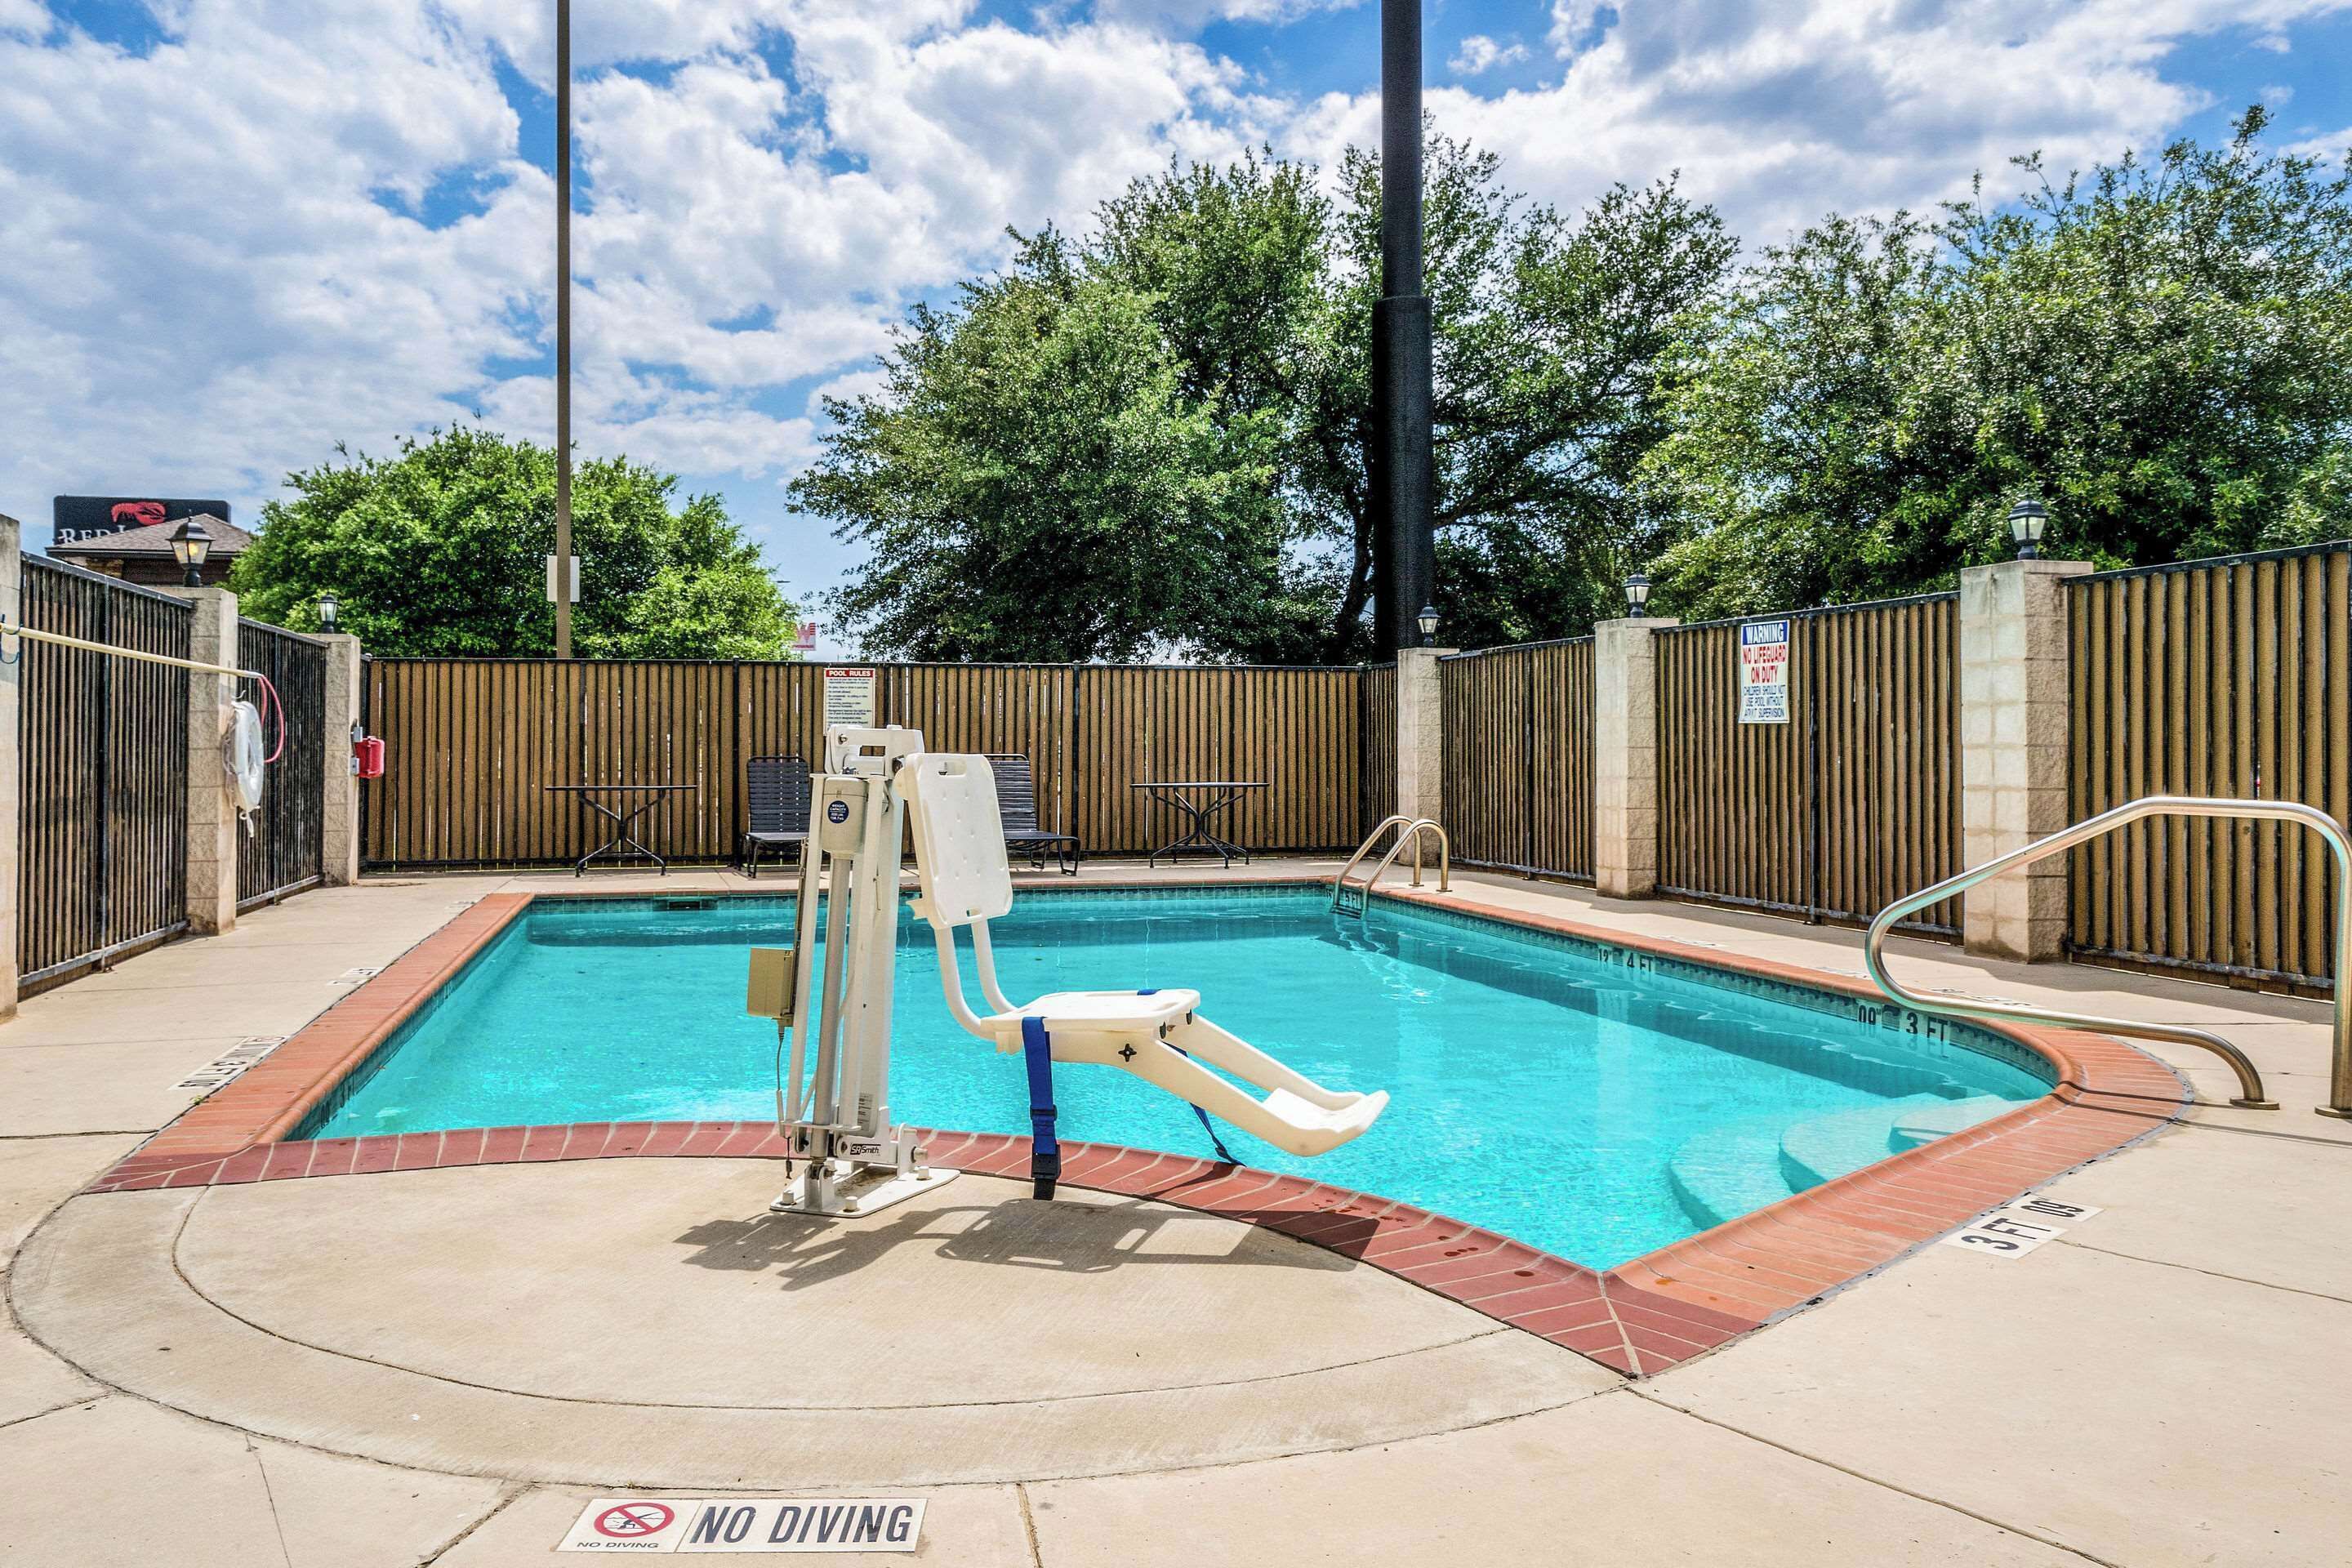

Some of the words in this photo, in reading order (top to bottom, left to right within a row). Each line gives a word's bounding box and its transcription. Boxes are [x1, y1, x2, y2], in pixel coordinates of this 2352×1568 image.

[60, 528, 111, 544] RED
[1746, 623, 1784, 644] WARNING
[1743, 647, 1751, 664] NO
[1753, 644, 1786, 664] LIFEGUARD
[1751, 666, 1760, 684] ON
[1762, 666, 1779, 683] DUTY
[1627, 952, 1635, 968] 4
[1640, 955, 1654, 973] FT
[1906, 1013, 1918, 1035] 3
[1927, 1017, 1949, 1041] FT
[1980, 1218, 2051, 1240] FT
[1961, 1235, 2020, 1251] 3
[689, 1506, 756, 1544] NO
[767, 1505, 913, 1544] DIVING
